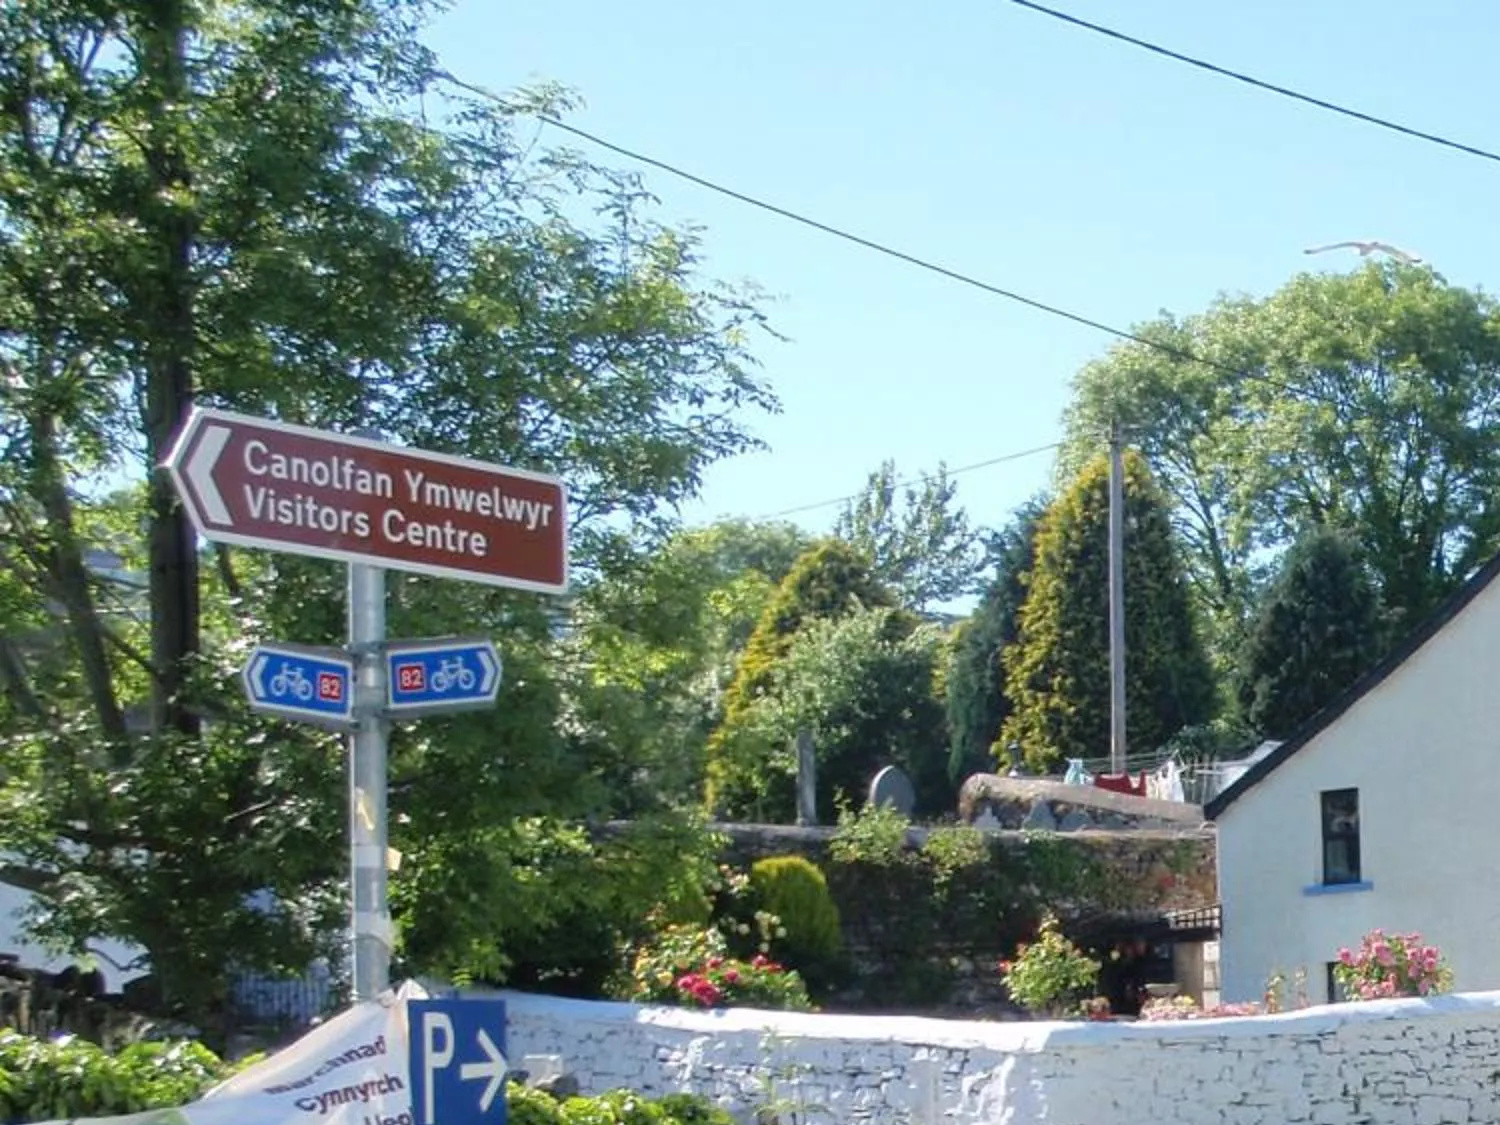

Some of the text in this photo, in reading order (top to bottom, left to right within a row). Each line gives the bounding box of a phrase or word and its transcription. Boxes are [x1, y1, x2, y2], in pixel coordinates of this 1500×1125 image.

[243, 440, 553, 531] Canolfan Ymwelwyr
[243, 483, 489, 557] Visitors Centre
[320, 676, 340, 697] 82
[400, 668, 423, 688] 82
[423, 1011, 455, 1125] P
